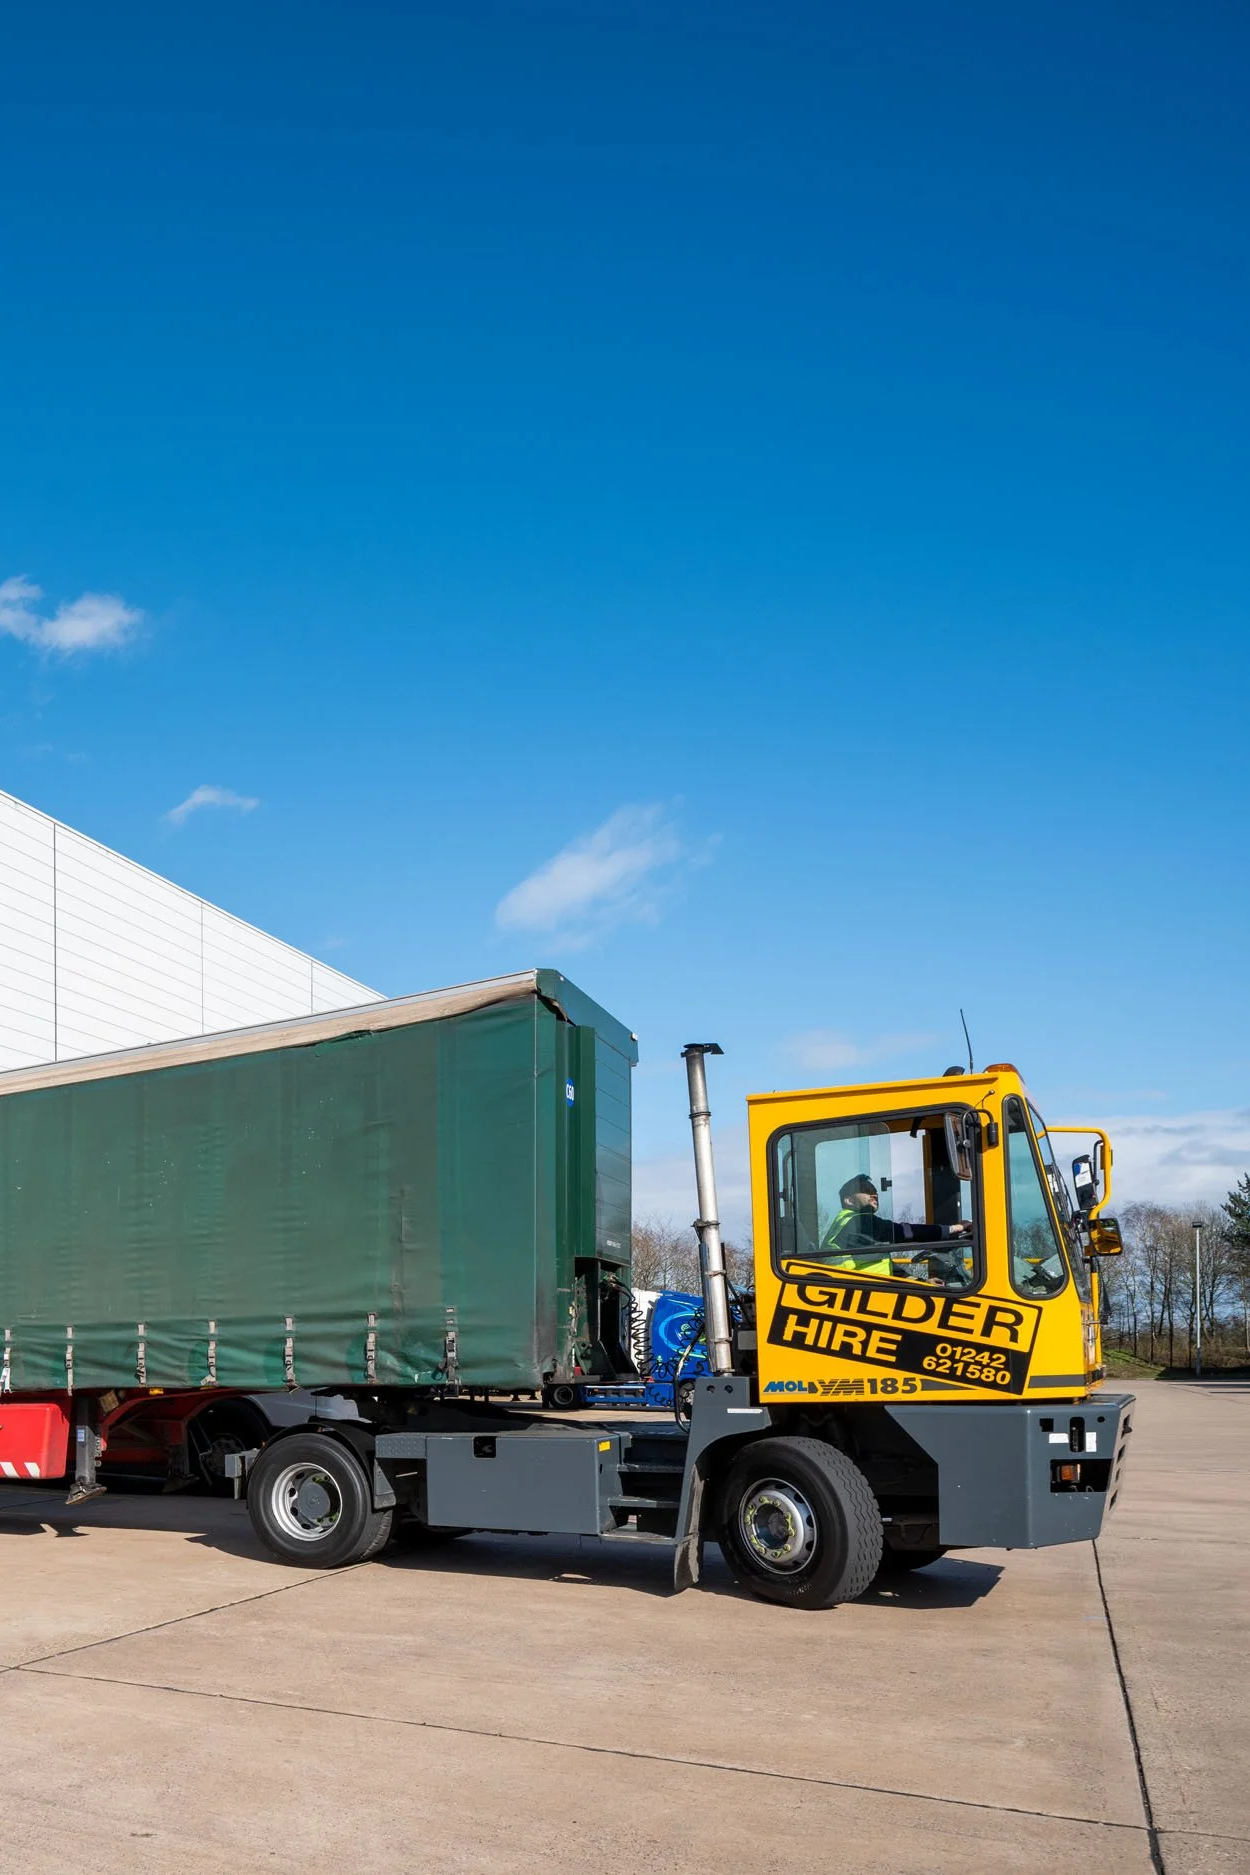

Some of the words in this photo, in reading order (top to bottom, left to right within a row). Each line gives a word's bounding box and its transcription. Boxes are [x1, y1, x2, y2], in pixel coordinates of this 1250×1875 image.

[796, 1272, 1025, 1344] GILDER
[782, 1314, 902, 1362] HIRE
[922, 1356, 1011, 1385] 621580
[935, 1343, 1007, 1369] 01242
[763, 1380, 809, 1393] MOL
[817, 1378, 865, 1396] YM
[867, 1377, 918, 1395] 185
